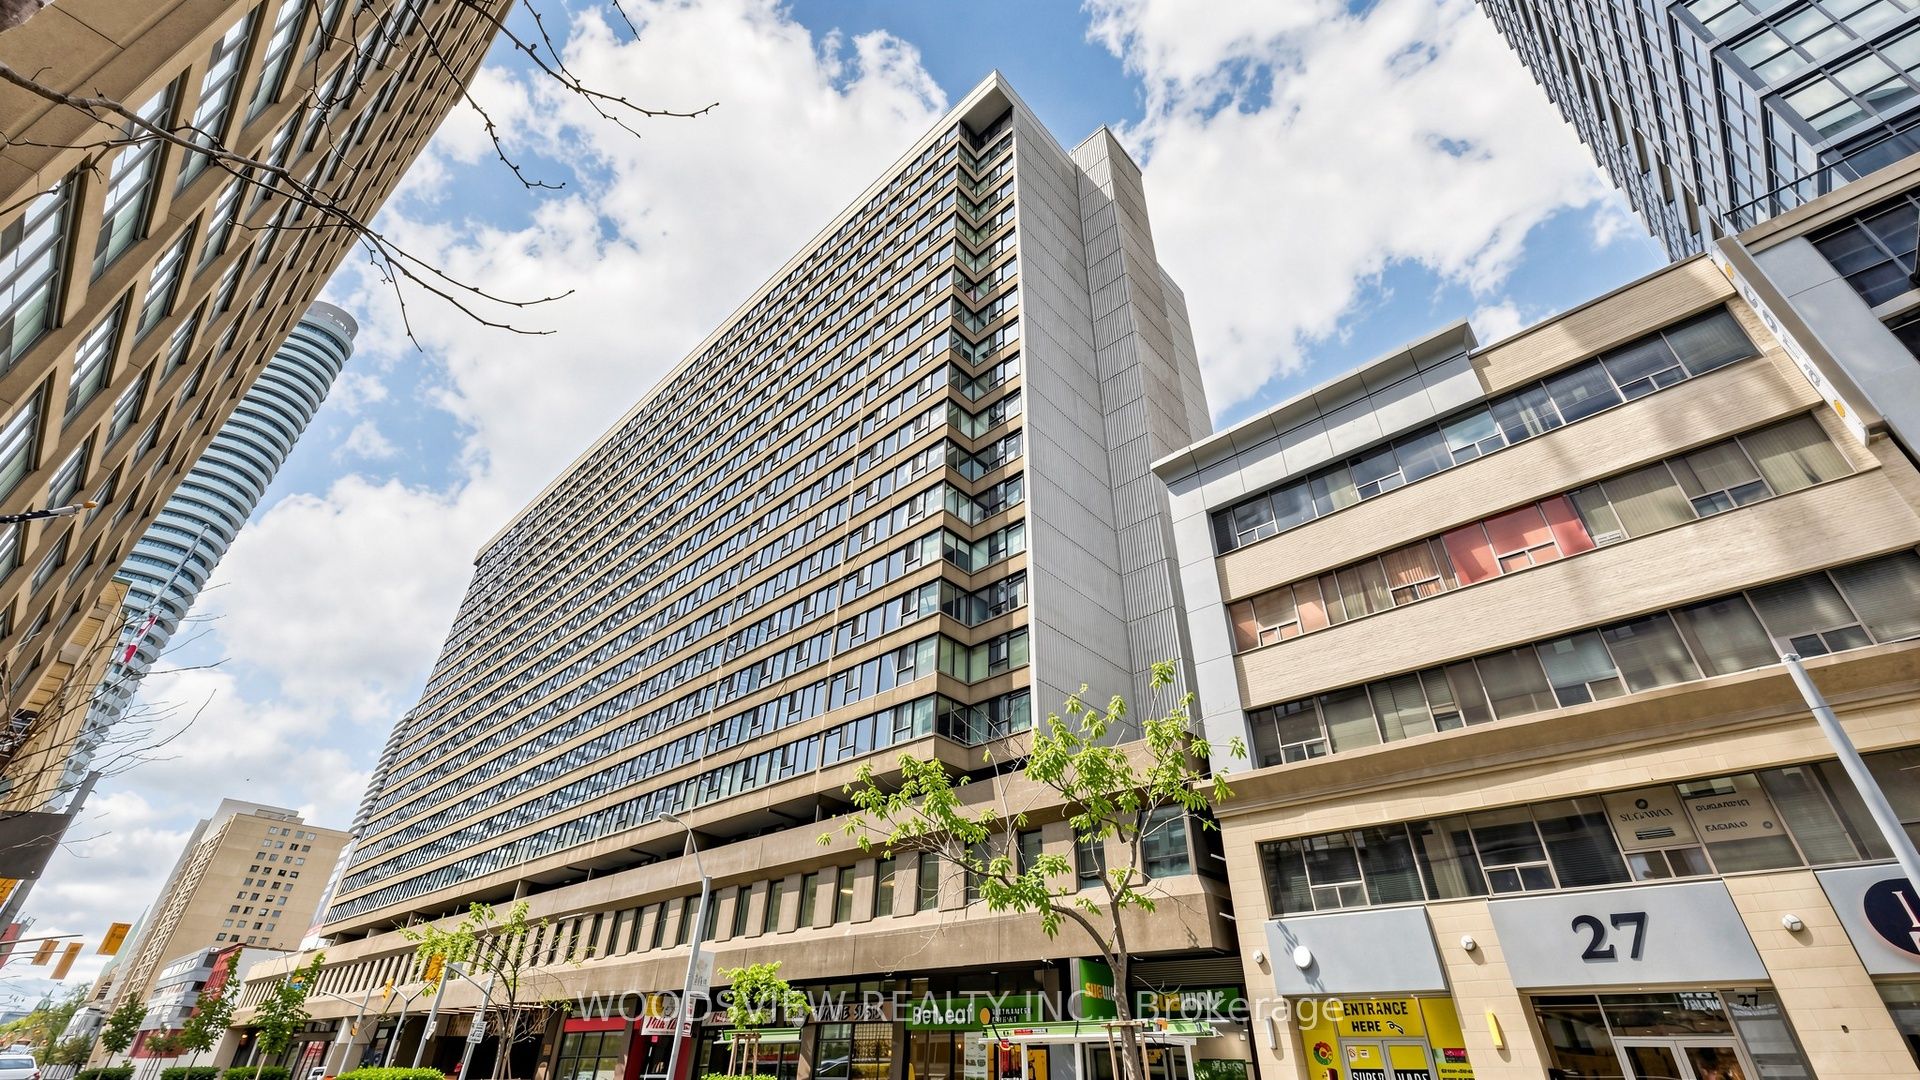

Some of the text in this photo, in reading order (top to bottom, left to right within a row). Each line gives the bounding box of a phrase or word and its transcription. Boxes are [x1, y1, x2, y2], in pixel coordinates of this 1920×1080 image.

[1570, 911, 1648, 961] 27
[1737, 994, 1759, 1007] 27
[1343, 1001, 1408, 1016] ENTRANCE
[1351, 1020, 1382, 1033] HERE
